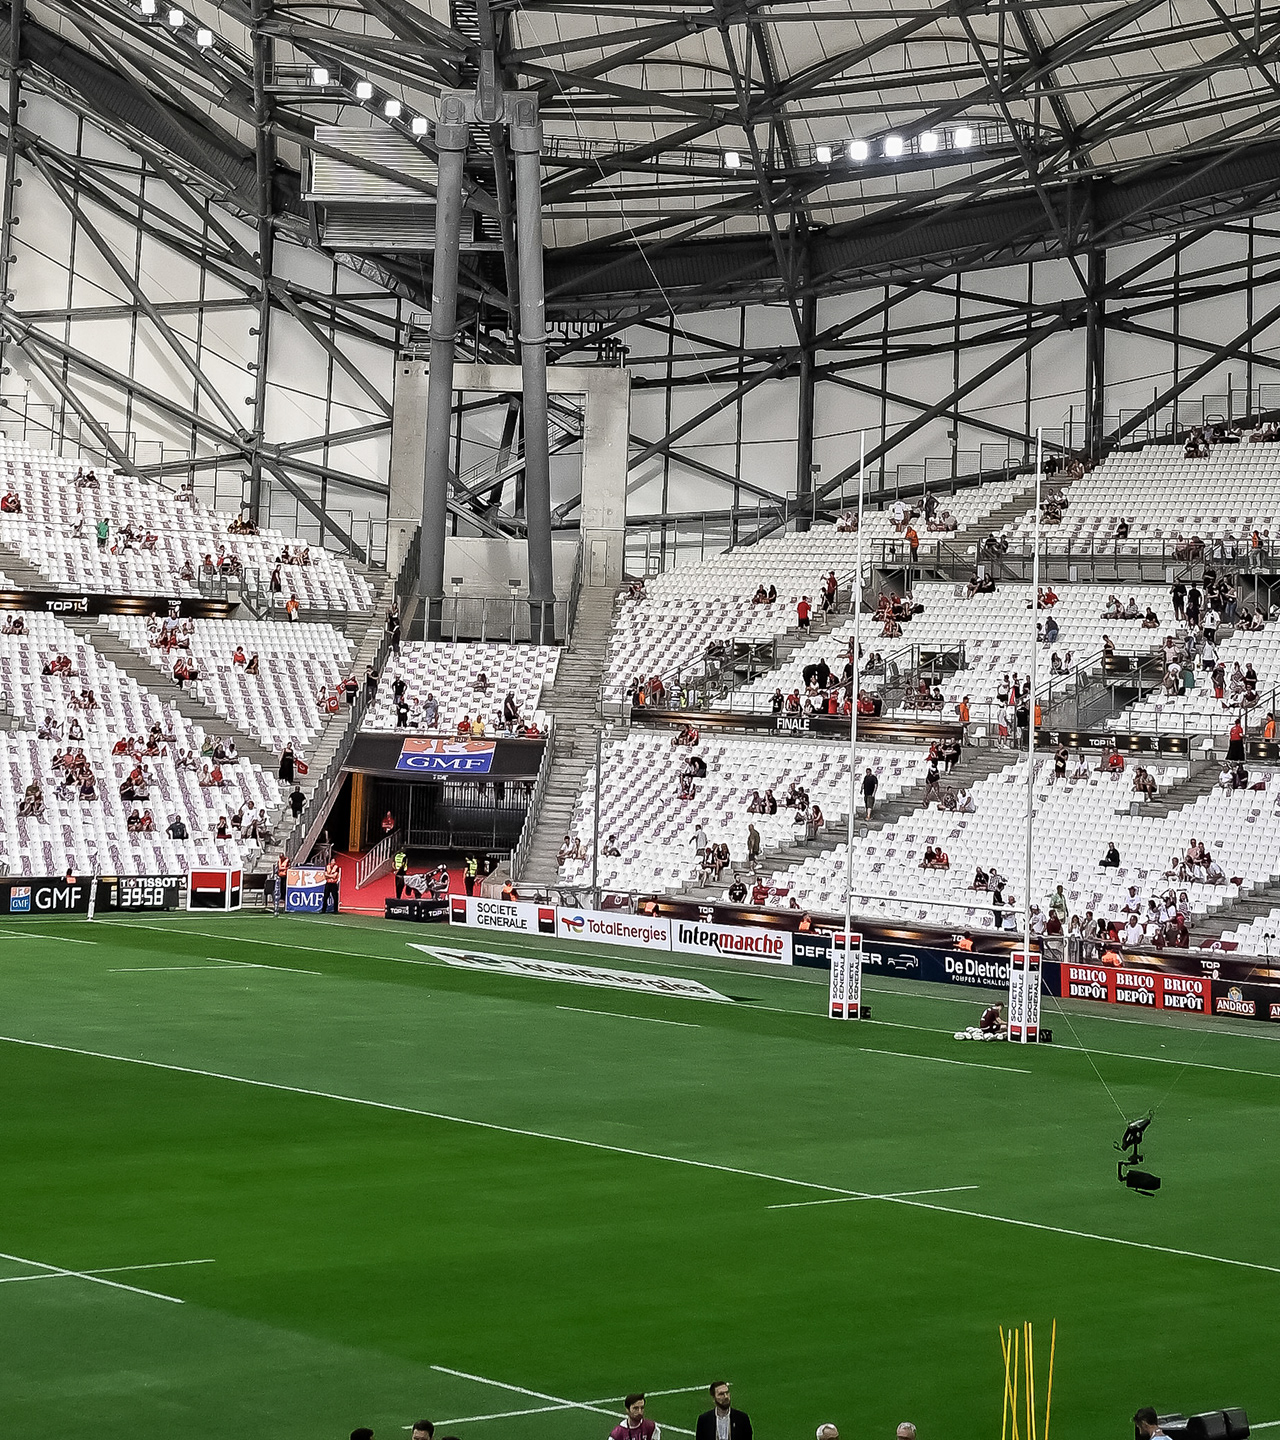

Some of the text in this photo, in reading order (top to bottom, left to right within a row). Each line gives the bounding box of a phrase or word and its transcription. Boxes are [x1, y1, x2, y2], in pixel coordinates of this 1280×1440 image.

[776, 717, 810, 730] FINALE
[406, 756, 485, 770] GMF
[11, 899, 30, 908] GMF
[35, 886, 82, 909] GMF
[121, 887, 165, 907] 39:58
[289, 891, 325, 906] GMF
[476, 902, 518, 917] SOCIETE
[698, 906, 715, 914] TOP
[476, 914, 528, 929] GENERALE
[587, 918, 667, 943] TotalEnergies
[794, 945, 882, 965] DEFEER
[945, 956, 1011, 979] De Dietrich
[1201, 960, 1220, 969] TOP
[508, 960, 711, 995] TotalEnergies
[982, 978, 1010, 986] CHALEUR
[1069, 967, 1107, 983] BRICO
[1116, 972, 1154, 988] BRICO
[1069, 982, 1107, 999] DEPÔT
[1163, 977, 1203, 993] BRICO
[1116, 987, 1154, 1005] DEPÔT
[1164, 992, 1203, 1010] DEPÔT
[1217, 1000, 1255, 1014] ANDROS
